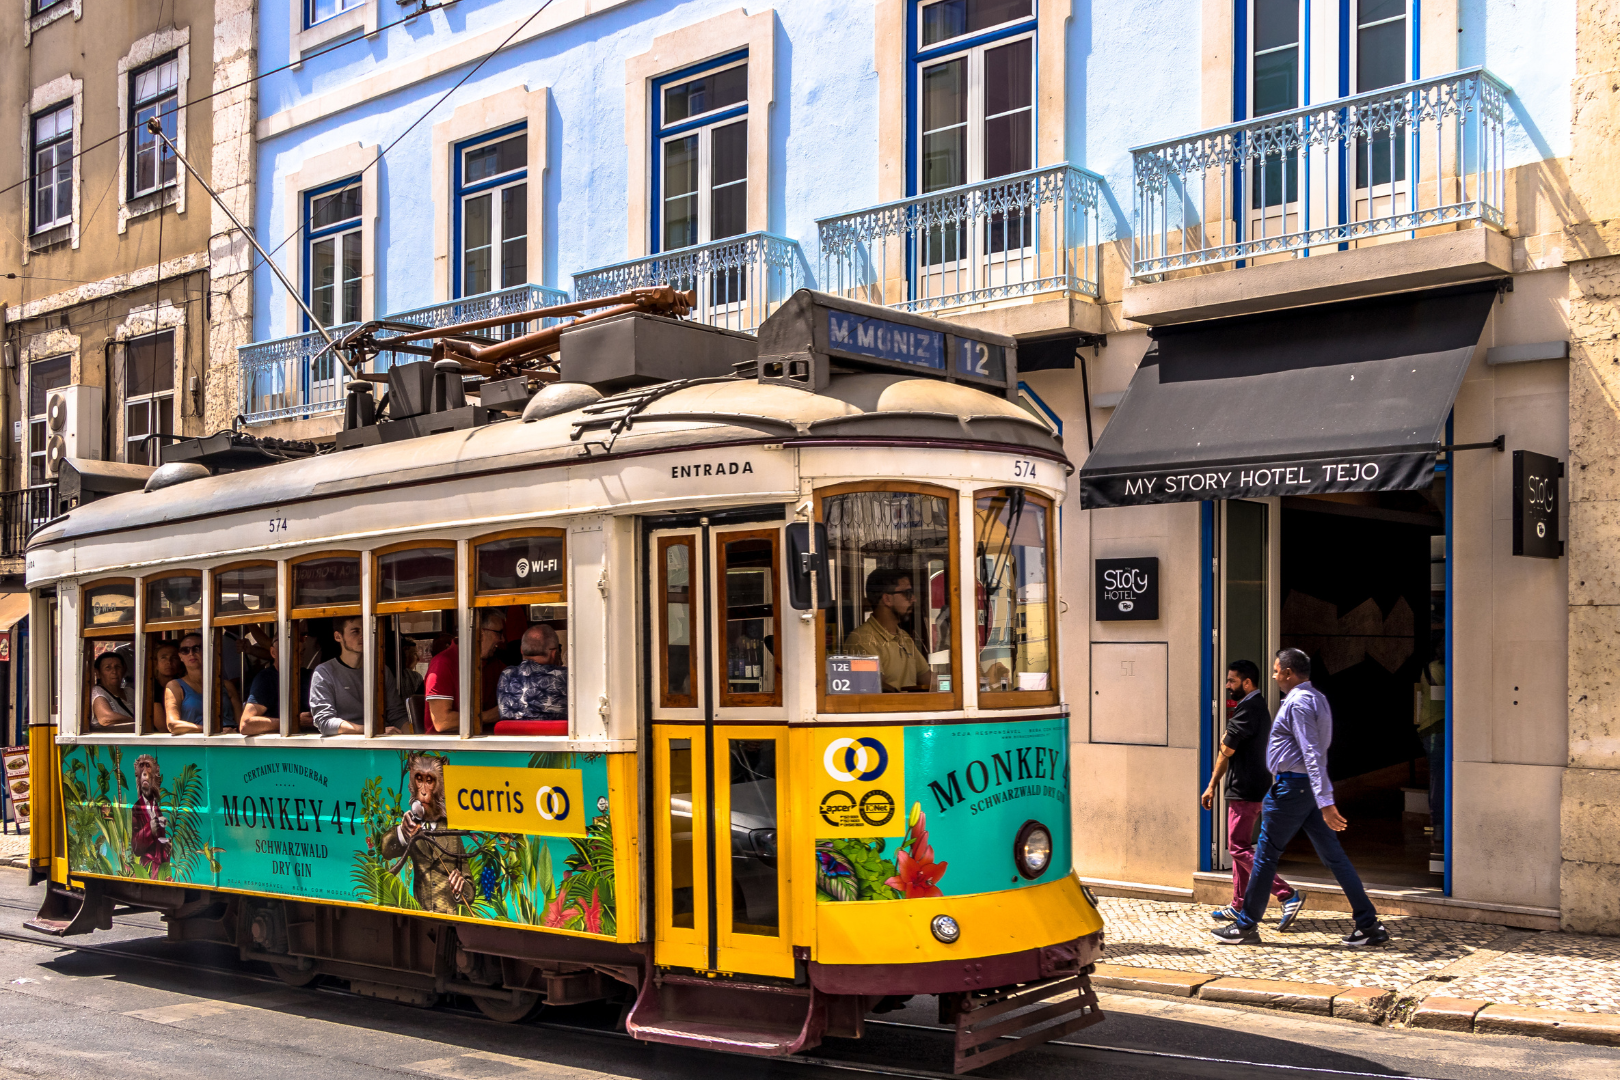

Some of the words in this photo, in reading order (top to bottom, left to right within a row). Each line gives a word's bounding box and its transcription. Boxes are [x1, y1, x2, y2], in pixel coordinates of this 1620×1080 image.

[964, 341, 989, 375] 12
[671, 462, 753, 478] ENTRADA
[1014, 461, 1036, 479] 574
[1124, 477, 1157, 496] MY
[1165, 472, 1232, 492] STORY
[1240, 466, 1311, 487] HOTEL
[1322, 462, 1379, 482] TEJO
[269, 517, 287, 532] 574
[531, 559, 558, 573] WI-FI
[1104, 590, 1137, 600] HOTEL
[832, 663, 850, 672] 12E
[832, 679, 851, 691] 02
[243, 763, 280, 783] CERTAINLY
[282, 763, 329, 787] WUNDERBAR
[927, 746, 1060, 814] MONKEY
[457, 781, 524, 814] carris
[970, 784, 1042, 816] SCHWARZWALD
[222, 795, 323, 833] MONKEY
[331, 800, 357, 836] 47
[255, 839, 328, 859] SCHWARZWALD
[272, 861, 291, 876] DRY
[295, 863, 312, 878] GIN
